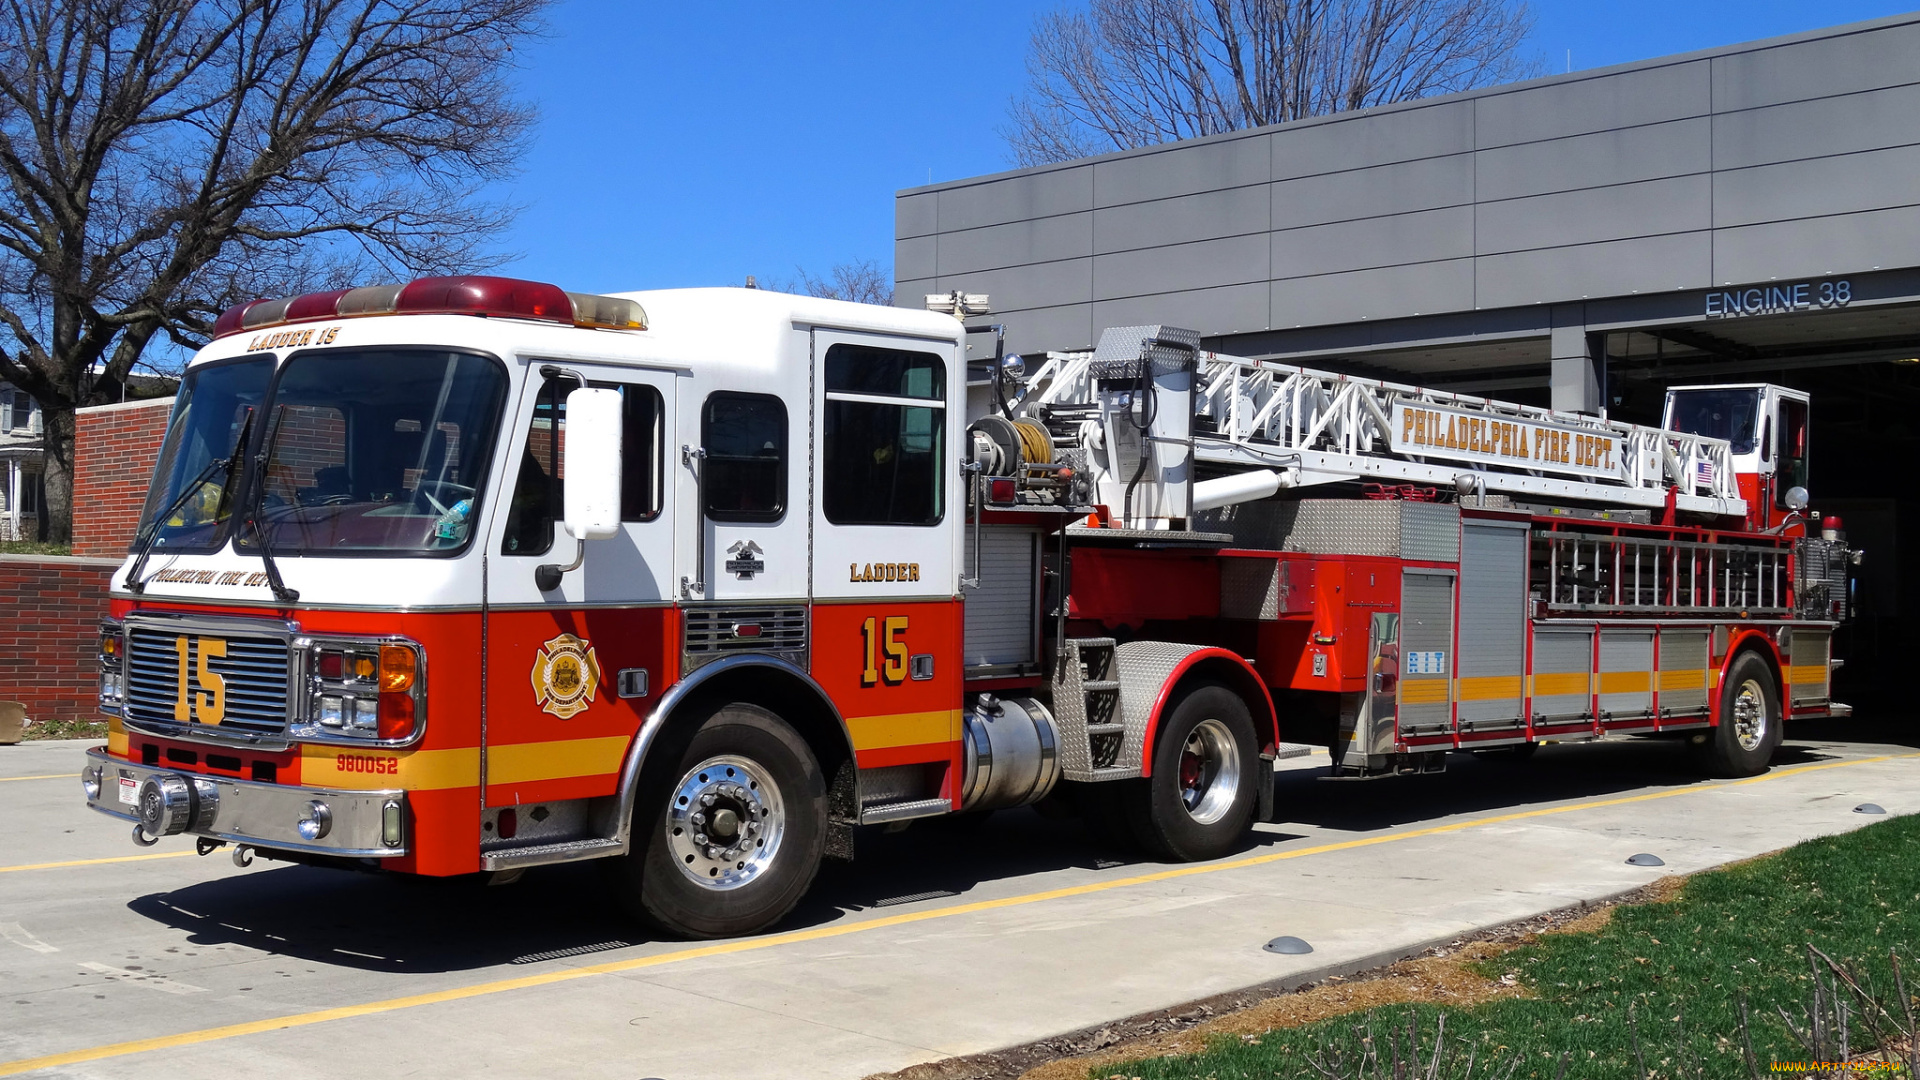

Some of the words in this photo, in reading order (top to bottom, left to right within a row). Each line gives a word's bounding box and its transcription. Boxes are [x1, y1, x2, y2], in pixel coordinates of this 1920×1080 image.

[1705, 284, 1810, 315] ENGINE
[1818, 280, 1851, 304] 38
[247, 328, 316, 352] LADDER
[316, 327, 342, 346] 15
[1402, 407, 1529, 459] PHILADELPHIA
[1534, 428, 1570, 464] FIRE
[1575, 433, 1616, 470] DEPT.
[215, 571, 248, 586] FIRE
[243, 572, 271, 587] DEP
[850, 562, 920, 583] LADDER
[547, 646, 586, 662] PHILADELPHIA
[860, 616, 909, 688] 15
[1409, 652, 1443, 673] RIT
[174, 634, 227, 726] 15
[545, 687, 555, 702] FIRE
[555, 685, 587, 705] DEPARTMENT
[337, 753, 398, 775] 980052
